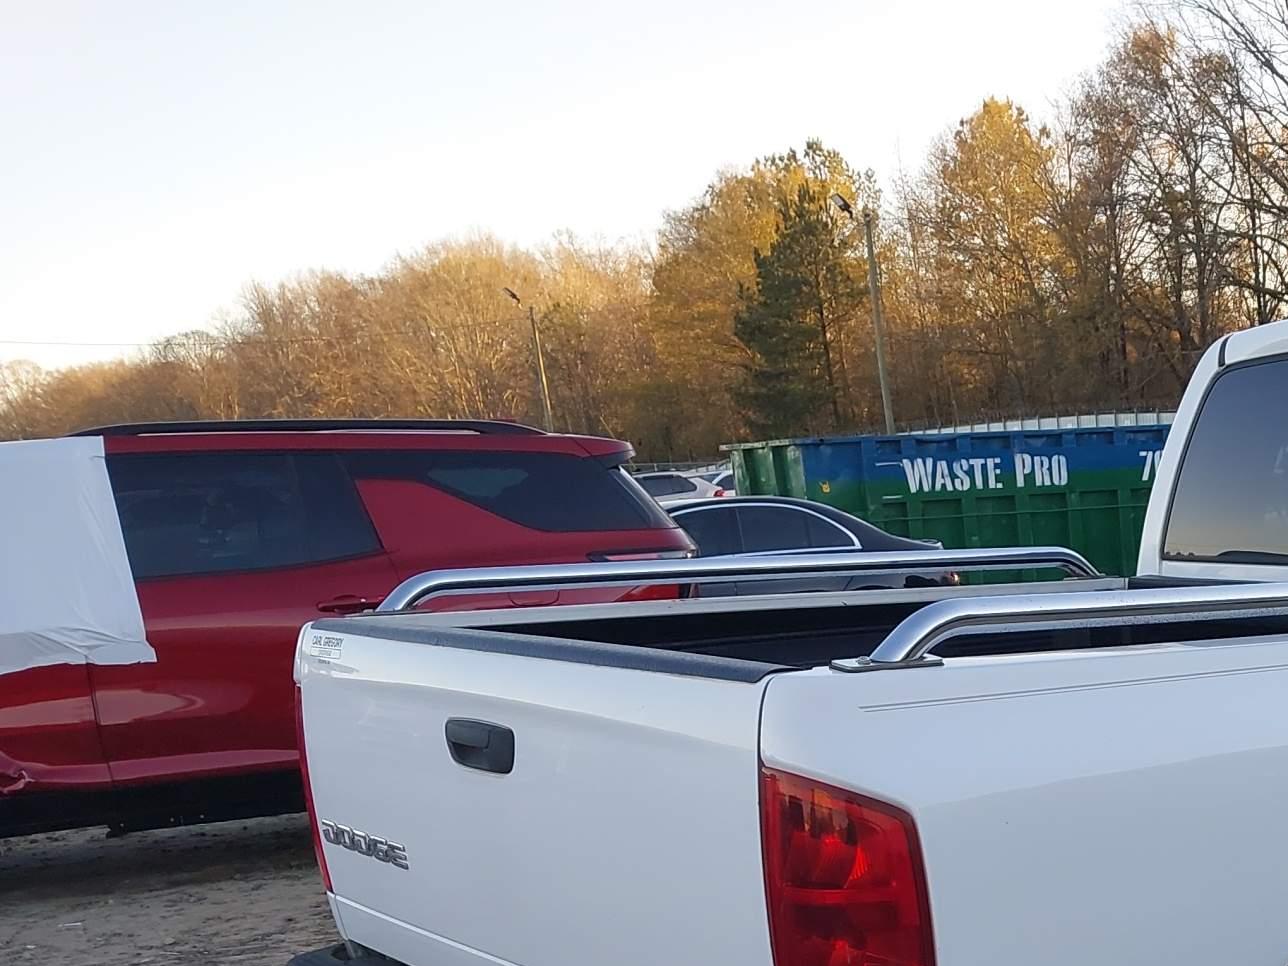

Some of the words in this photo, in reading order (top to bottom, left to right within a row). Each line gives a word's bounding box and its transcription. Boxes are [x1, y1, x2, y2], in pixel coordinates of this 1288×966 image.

[902, 456, 1004, 494] WASTE
[1014, 452, 1069, 488] PRO
[321, 818, 409, 871] DODGE
